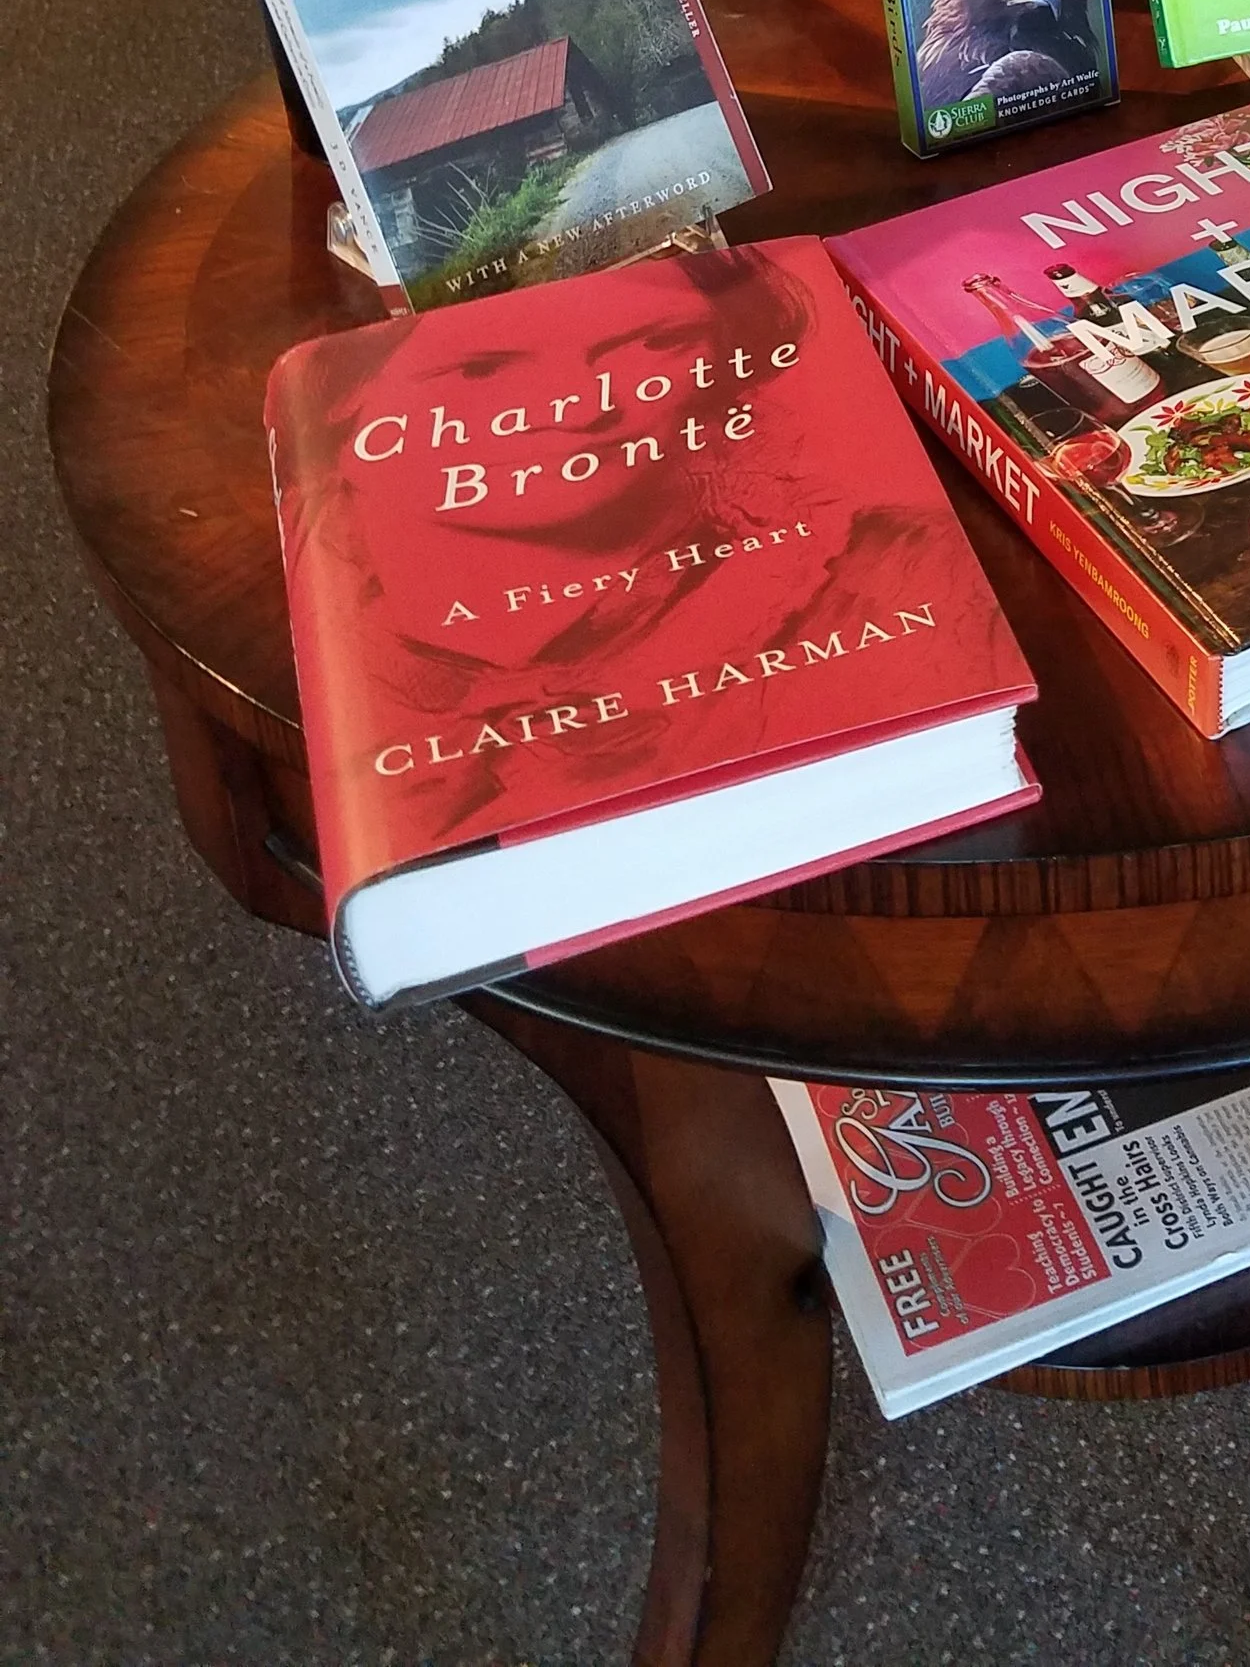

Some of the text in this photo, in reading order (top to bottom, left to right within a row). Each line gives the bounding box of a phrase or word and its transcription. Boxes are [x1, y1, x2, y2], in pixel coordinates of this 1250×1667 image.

[951, 102, 987, 119] SIERRA
[955, 112, 985, 127] CLUB
[997, 69, 1100, 106] Photographs by Art Wolfe
[998, 94, 1057, 118] KNOWLEDGE
[446, 170, 712, 294] WITH A NEW AFTERWORD
[1190, 216, 1238, 243] +
[352, 340, 802, 463] Charlotte
[903, 357, 1041, 526] + MARKET
[435, 404, 758, 513] Brontë
[440, 518, 815, 626] A Fiery Heart
[1049, 520, 1150, 640] KRIS YENBAMROONG
[374, 602, 939, 777] CLAIRE HARMAN
[986, 1099, 1037, 1192] Legacy through
[986, 1136, 1019, 1199] Building a
[1015, 1115, 1053, 1185] Connection
[1144, 1135, 1204, 1240] Fifth District Supervisor
[1161, 1134, 1216, 1228] Lynda Hopkins Looks
[1173, 1124, 1234, 1228] Both Ways on Cannabis
[1067, 1161, 1143, 1269] CAUGHT
[1116, 1175, 1150, 1227] in the
[1122, 1140, 1189, 1250] Cross Hairs
[1026, 1231, 1063, 1295] Teaching
[1033, 1198, 1080, 1287] Democracy to
[1062, 1220, 1097, 1280] Students
[879, 1249, 940, 1339] FREE
